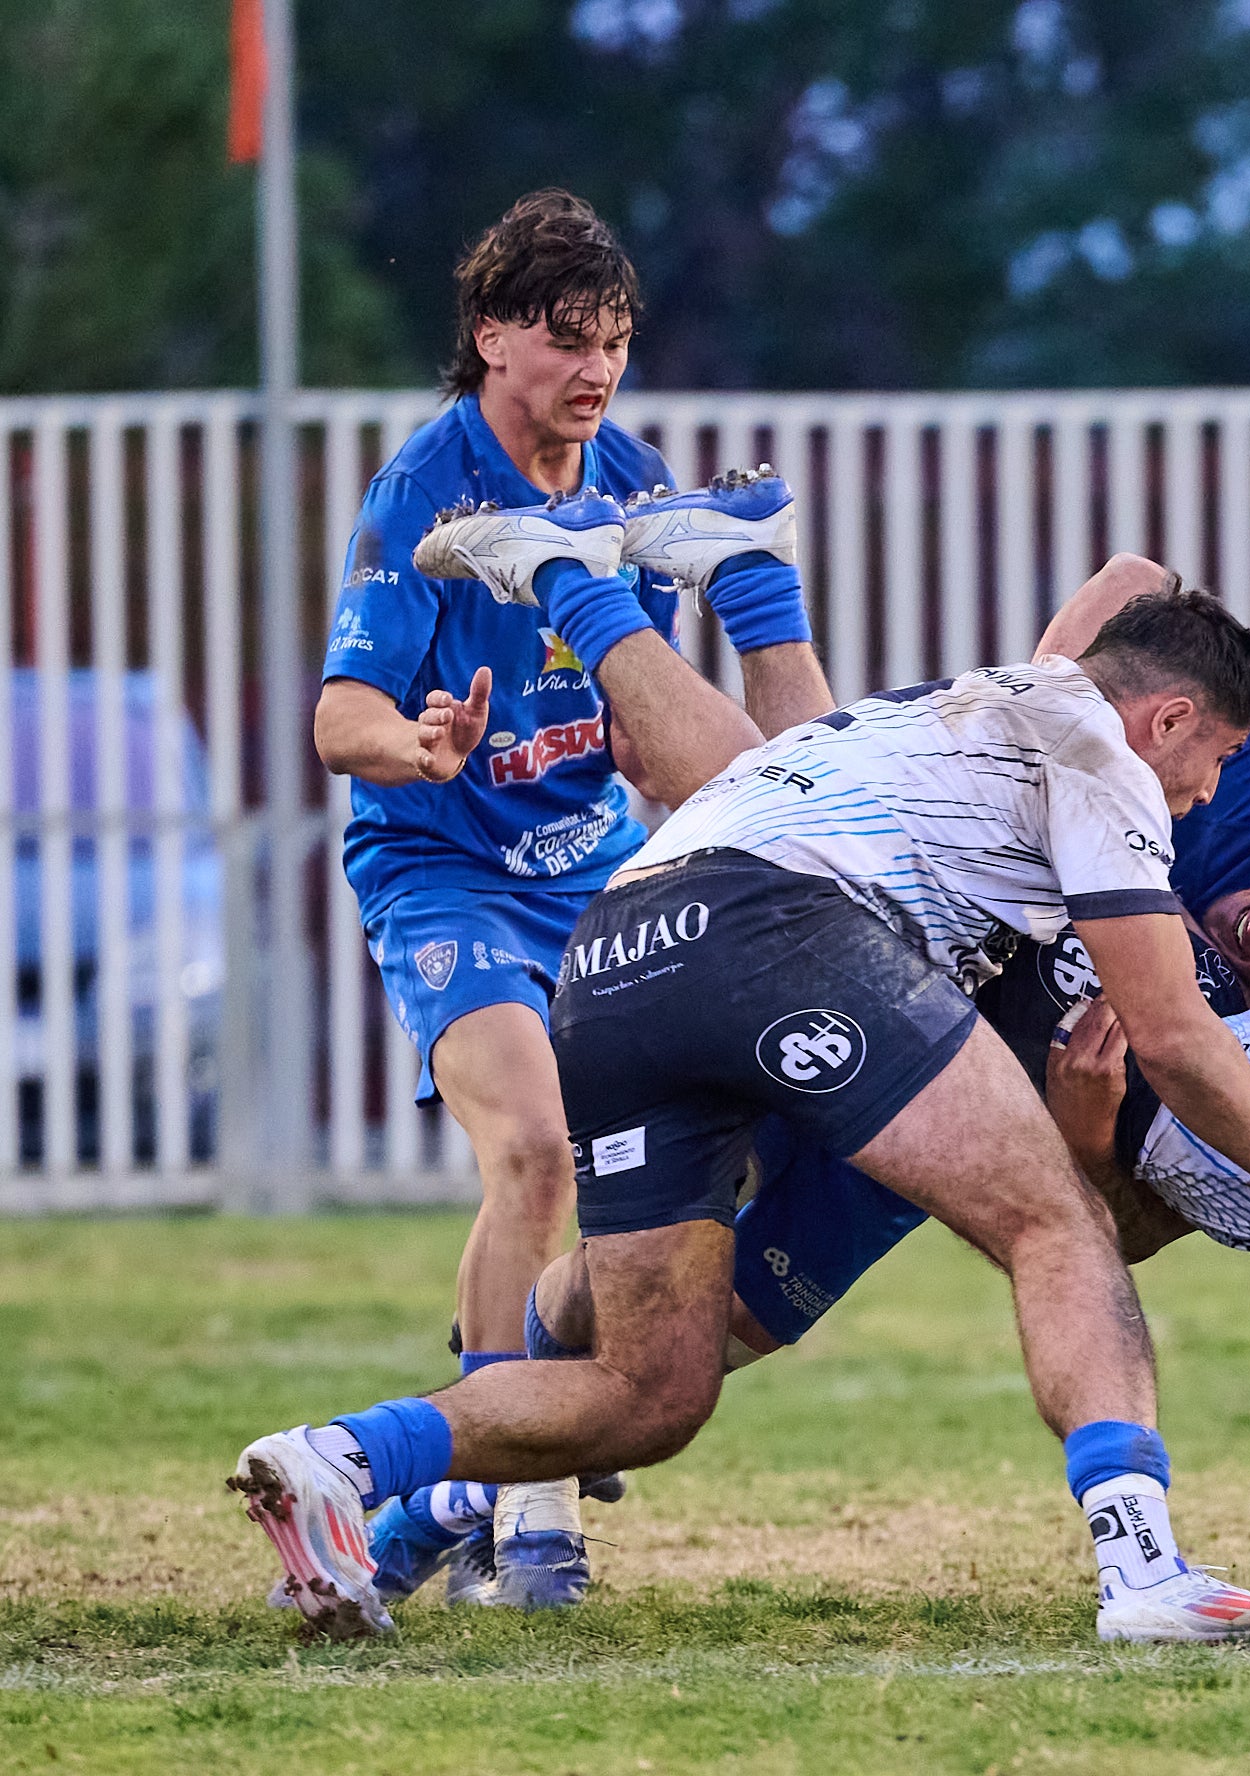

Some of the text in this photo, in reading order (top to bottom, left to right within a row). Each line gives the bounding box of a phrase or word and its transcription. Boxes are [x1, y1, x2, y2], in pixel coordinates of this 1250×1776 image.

[545, 849, 572, 877] DE
[570, 902, 710, 983] MAJAO
[779, 1282, 820, 1318] ALFONSO
